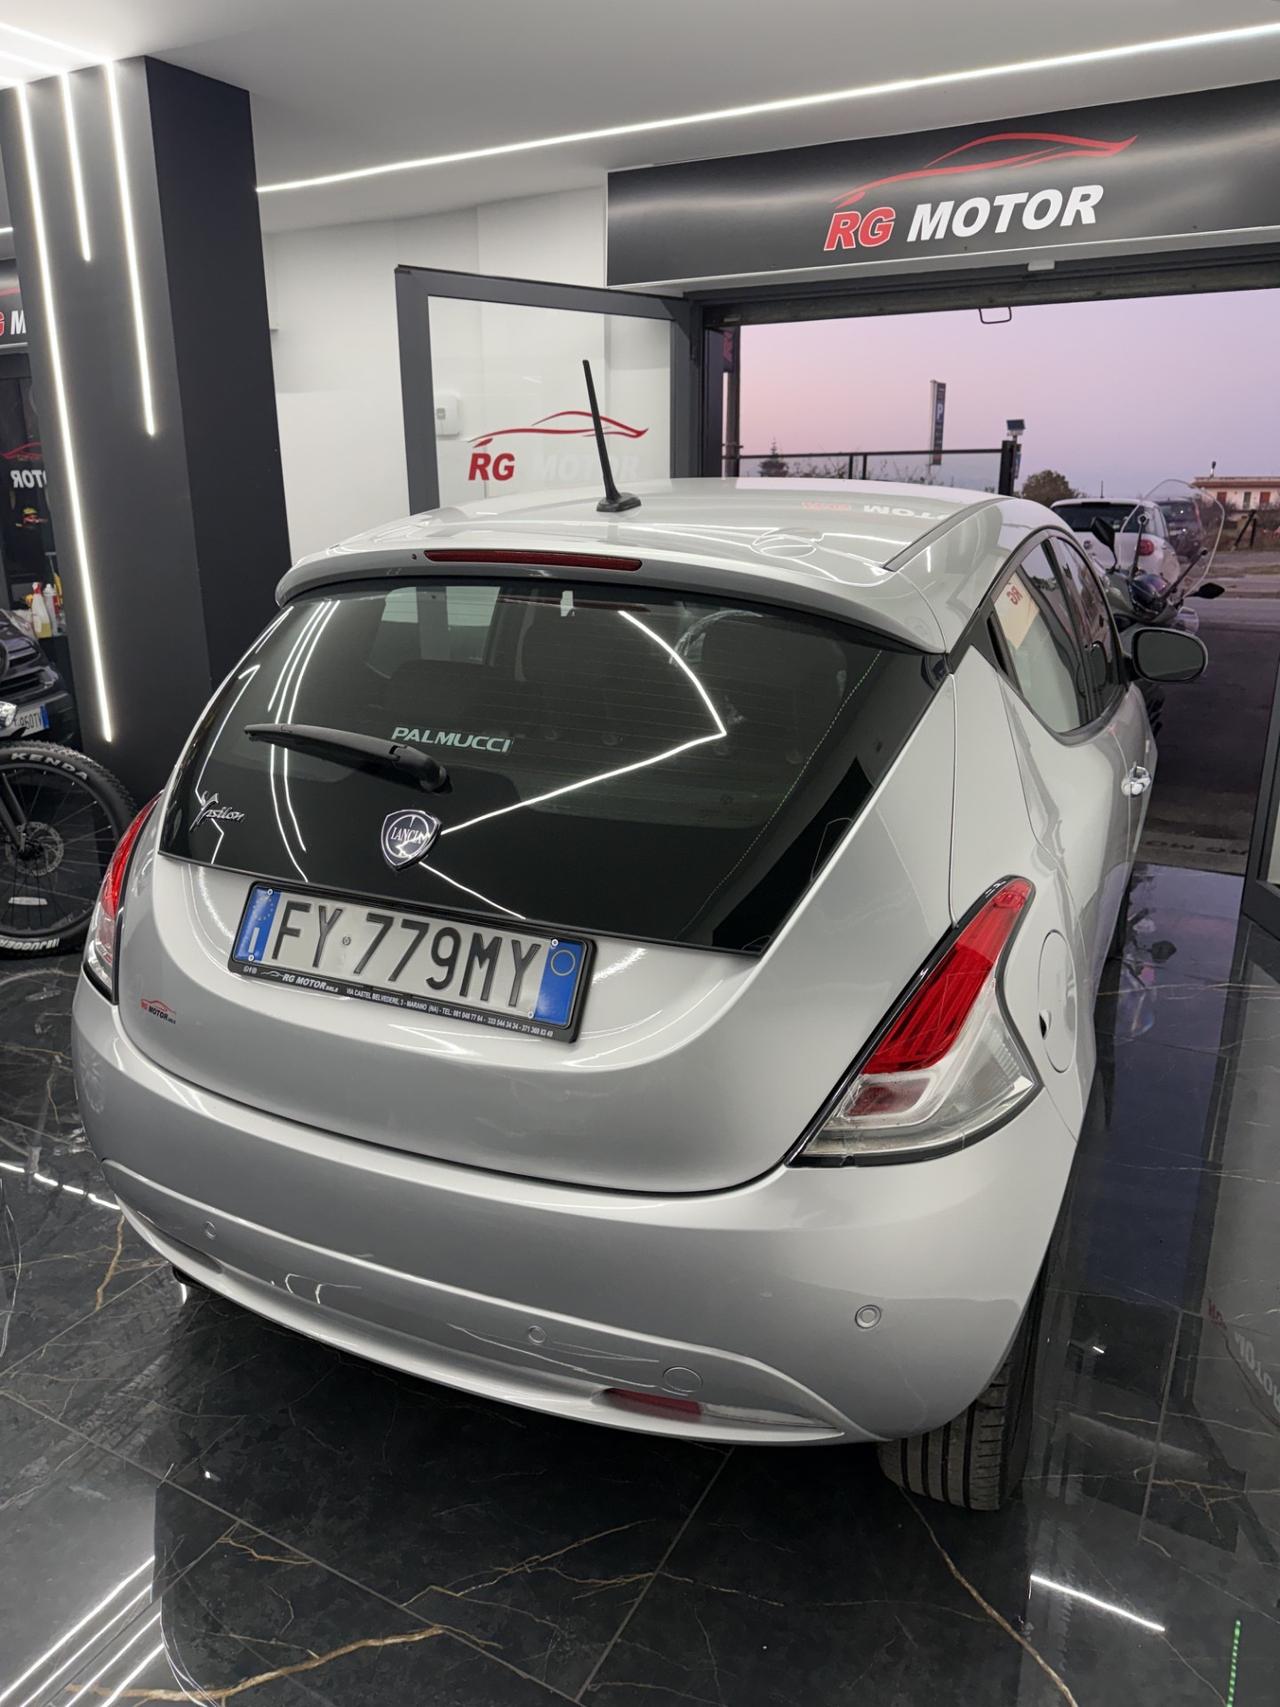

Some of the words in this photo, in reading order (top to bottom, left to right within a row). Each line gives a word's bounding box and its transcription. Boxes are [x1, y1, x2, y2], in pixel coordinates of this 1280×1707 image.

[823, 206, 896, 251] RG
[906, 184, 1104, 242] MOTOR
[468, 453, 515, 481] RG
[391, 726, 511, 753] PALMUCCI
[11, 752, 87, 780] KENDA
[271, 900, 343, 968] FY
[353, 913, 541, 1007] 779MY
[282, 973, 295, 983] RG
[296, 976, 326, 990] MOTOR
